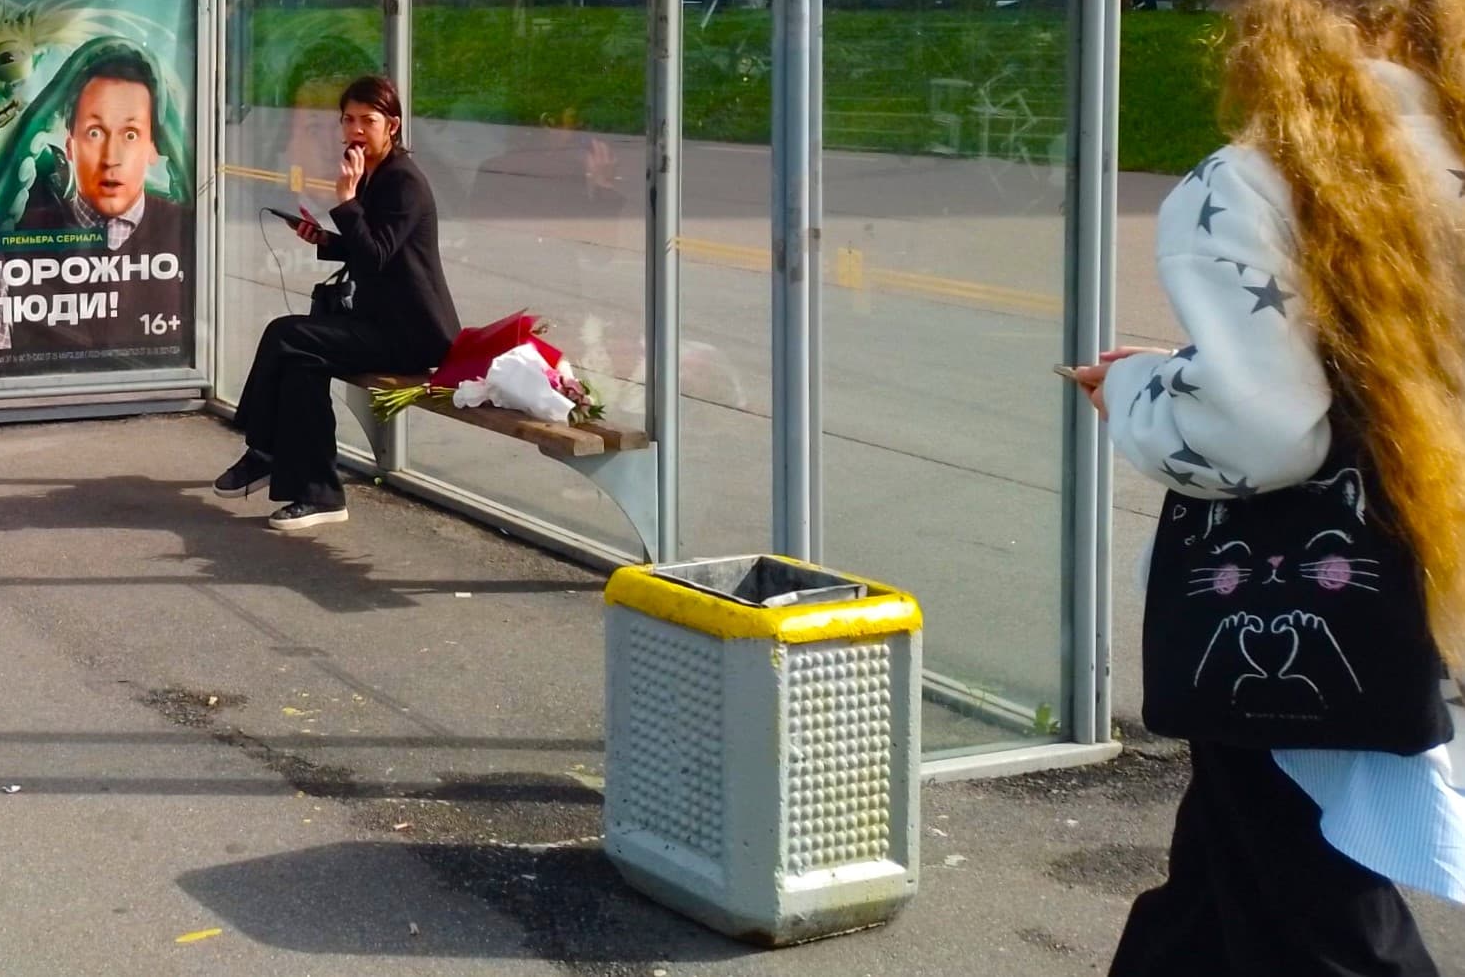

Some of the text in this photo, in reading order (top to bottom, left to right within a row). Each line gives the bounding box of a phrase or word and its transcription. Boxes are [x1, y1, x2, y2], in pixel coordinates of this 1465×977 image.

[1, 233, 103, 246] ПРЕМЬЕРА СЕРИАЛА
[139, 313, 181, 336] 16+
